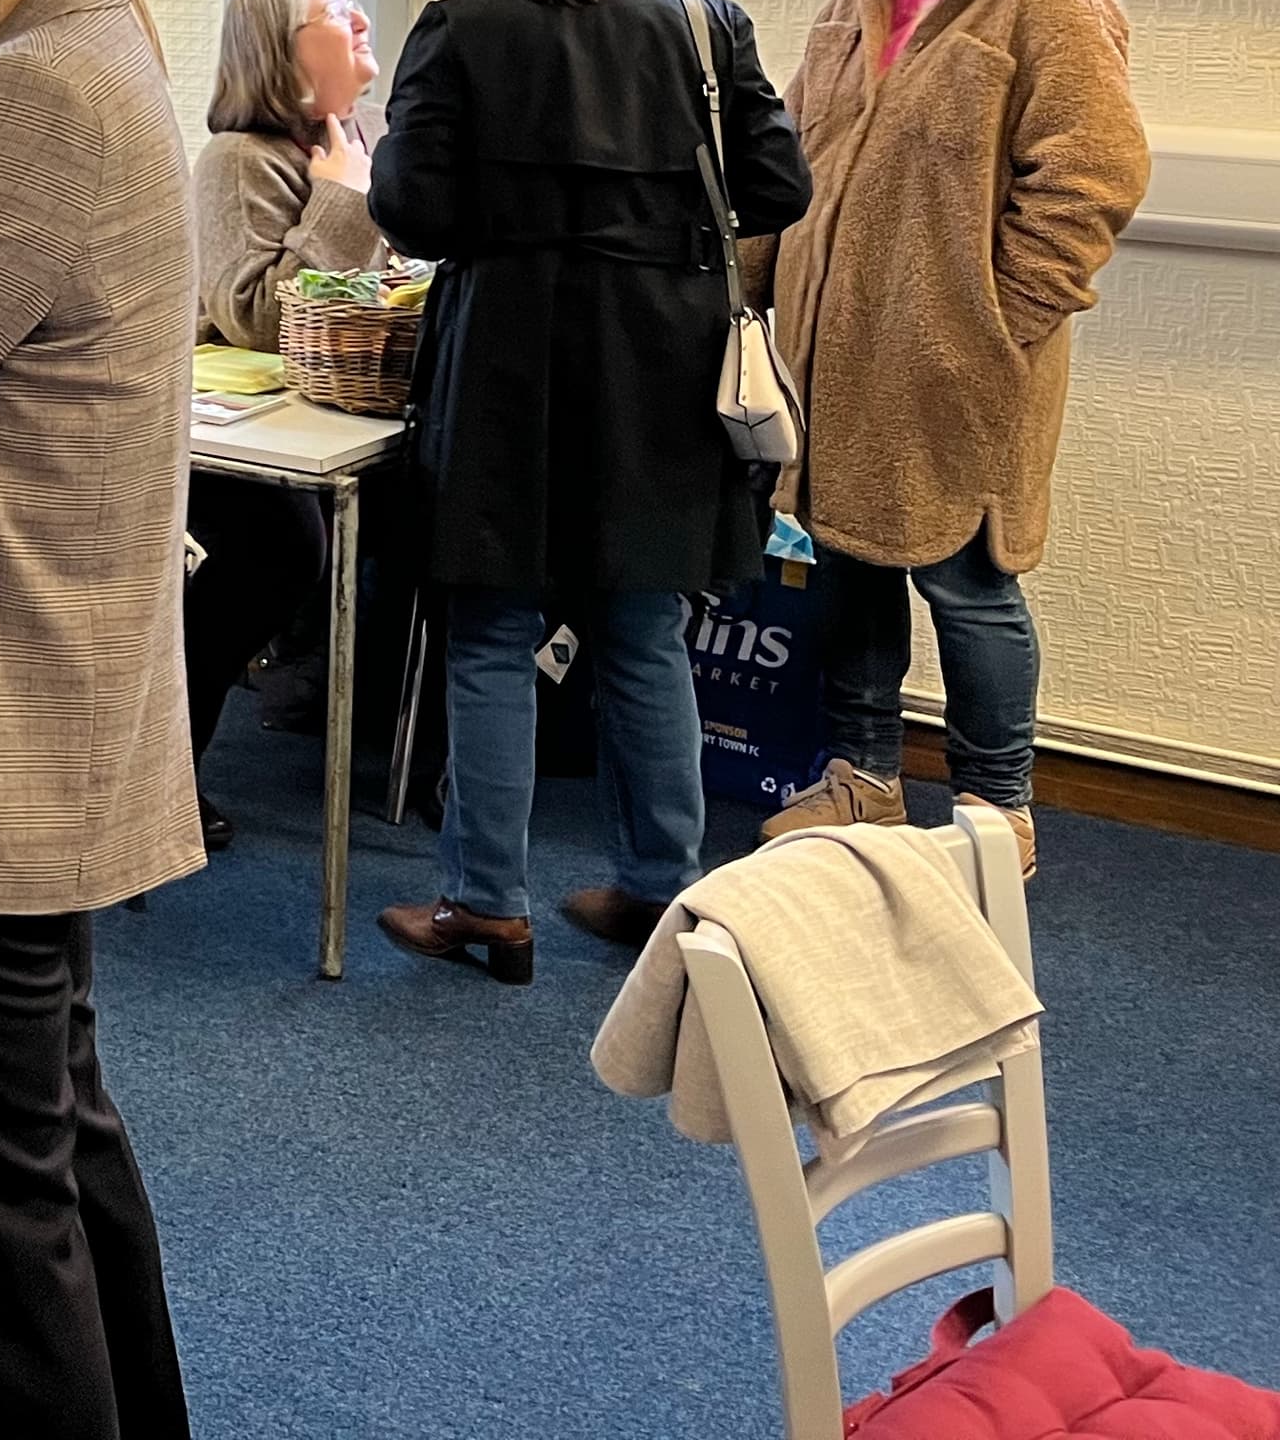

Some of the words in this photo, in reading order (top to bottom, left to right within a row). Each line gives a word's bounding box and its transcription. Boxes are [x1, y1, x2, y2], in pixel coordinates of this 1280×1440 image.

[691, 662, 780, 695] ARKET
[702, 733, 716, 745] RY
[718, 736, 747, 753] TOWN
[749, 745, 760, 757] FC
